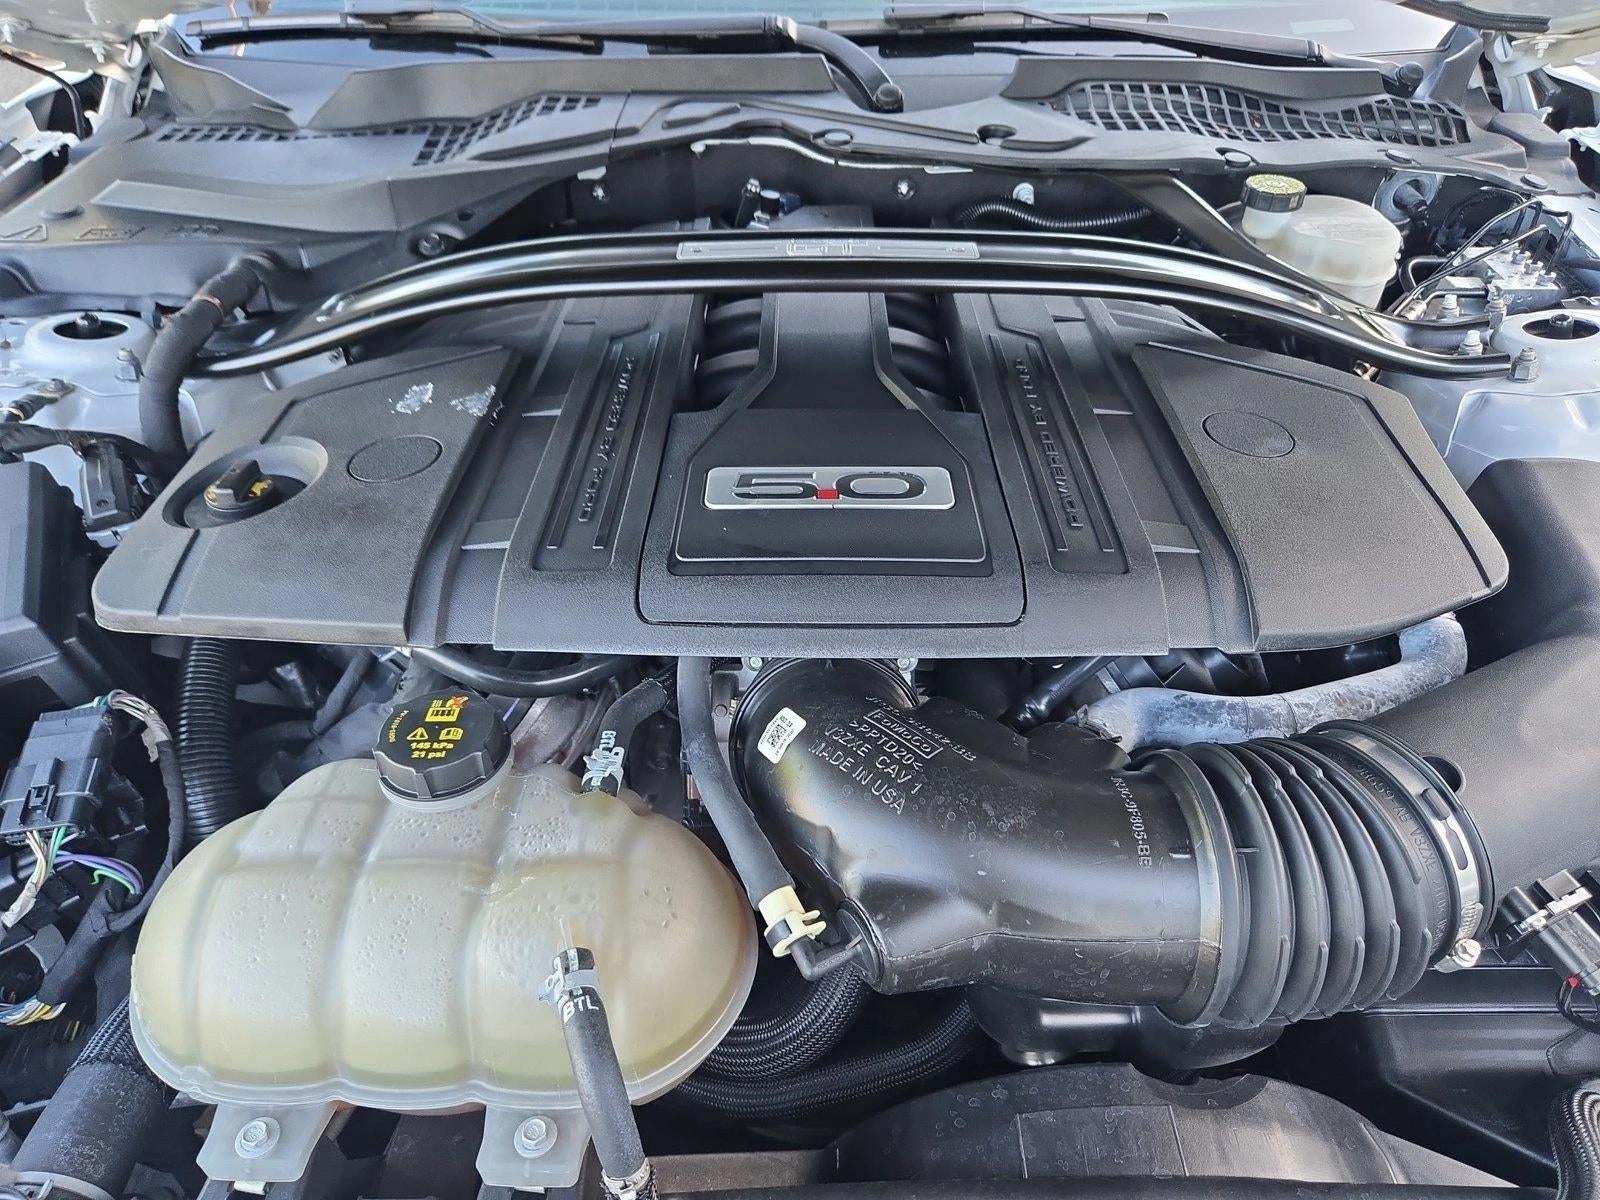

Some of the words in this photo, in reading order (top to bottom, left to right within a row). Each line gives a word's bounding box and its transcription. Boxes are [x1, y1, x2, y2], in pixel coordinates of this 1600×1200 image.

[731, 472, 927, 500] 5.0
[410, 742, 432, 750] 145
[432, 741, 454, 750] kPa
[598, 730, 617, 752] BTL
[872, 712, 933, 753] FoMoCo
[411, 751, 426, 759] 21
[427, 750, 446, 760] psi
[808, 738, 855, 773] MADE
[852, 765, 874, 786] IN
[871, 779, 907, 815] USA
[875, 755, 912, 785] CAV
[910, 782, 923, 795] 1
[562, 994, 600, 1025] BTL
